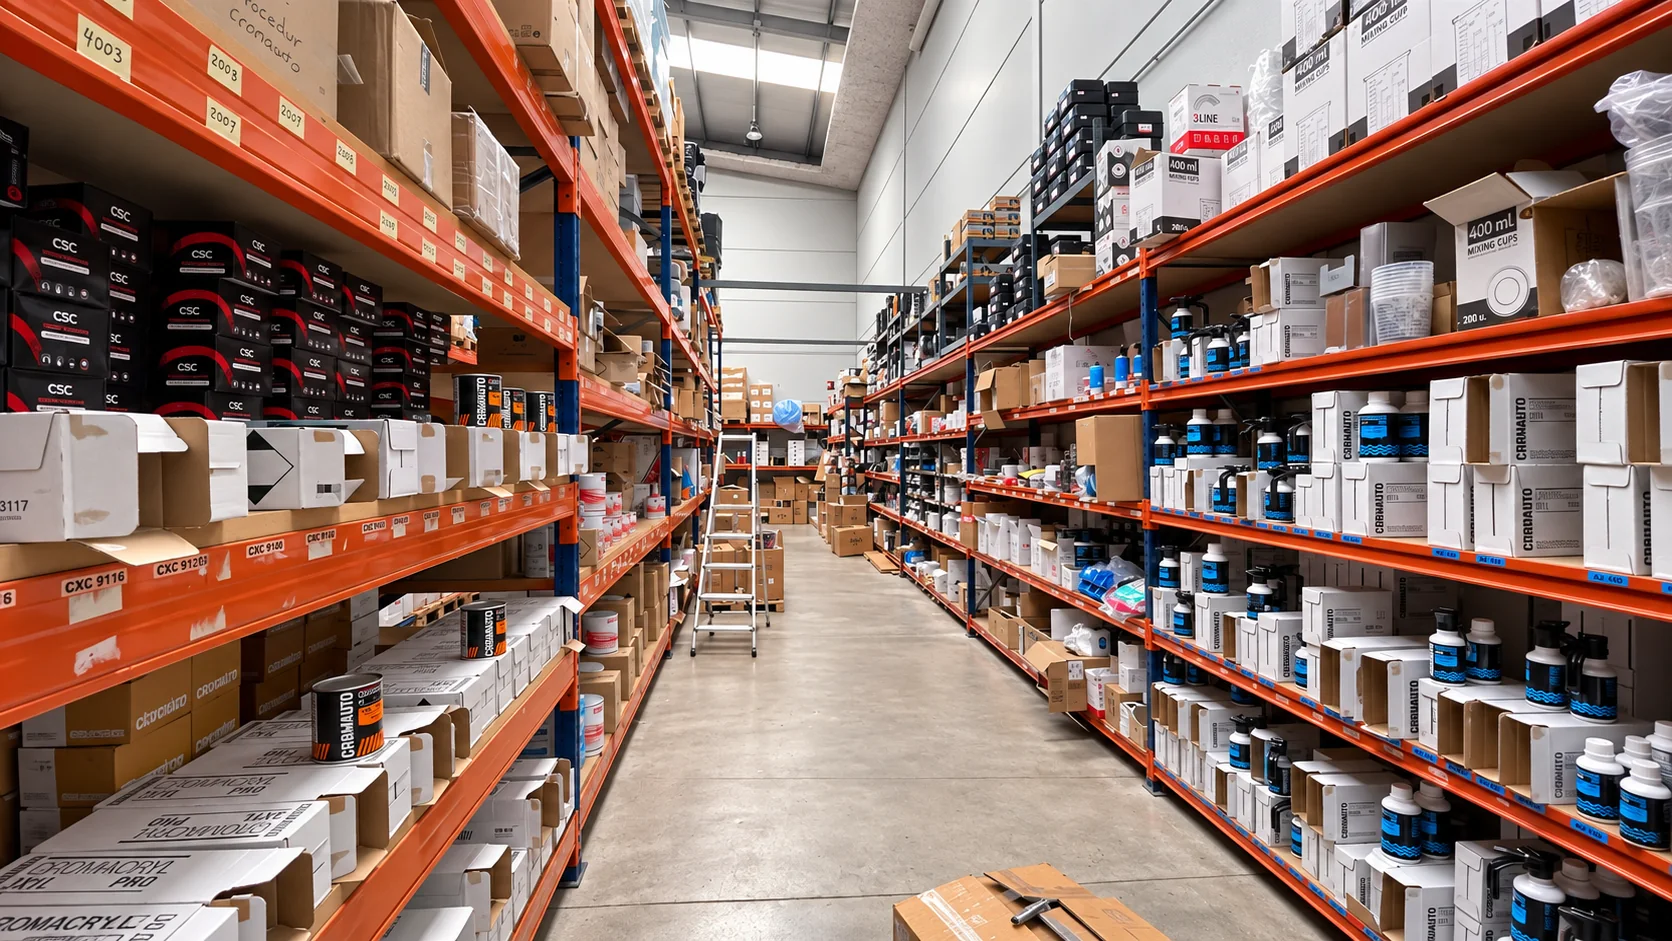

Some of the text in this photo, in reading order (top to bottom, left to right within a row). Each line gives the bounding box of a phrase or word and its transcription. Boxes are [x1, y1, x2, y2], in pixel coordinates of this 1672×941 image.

[83, 27, 123, 64] 4003
[210, 107, 237, 133] 2007
[1193, 113, 1218, 123] 3LINE
[110, 206, 131, 222] CSC
[1469, 220, 1492, 239] 400
[52, 237, 78, 254] CSC
[252, 240, 266, 253] CSC
[1468, 234, 1518, 256] MIXING CUPS
[191, 249, 213, 259] CSC
[318, 264, 330, 275] CSC
[109, 271, 128, 285] CSC
[240, 294, 254, 306] CSC
[179, 306, 200, 316] CSC
[313, 311, 325, 321] CSC
[53, 311, 78, 325] CSC
[1463, 313, 1477, 324] 200
[239, 348, 254, 359] CSC
[177, 363, 198, 372] CSC
[309, 358, 321, 368] CSC
[48, 383, 73, 396] CSC
[229, 401, 244, 411] CSC
[248, 545, 264, 556] CXC
[157, 562, 178, 576] CXC
[65, 571, 125, 593] CXC 9116
